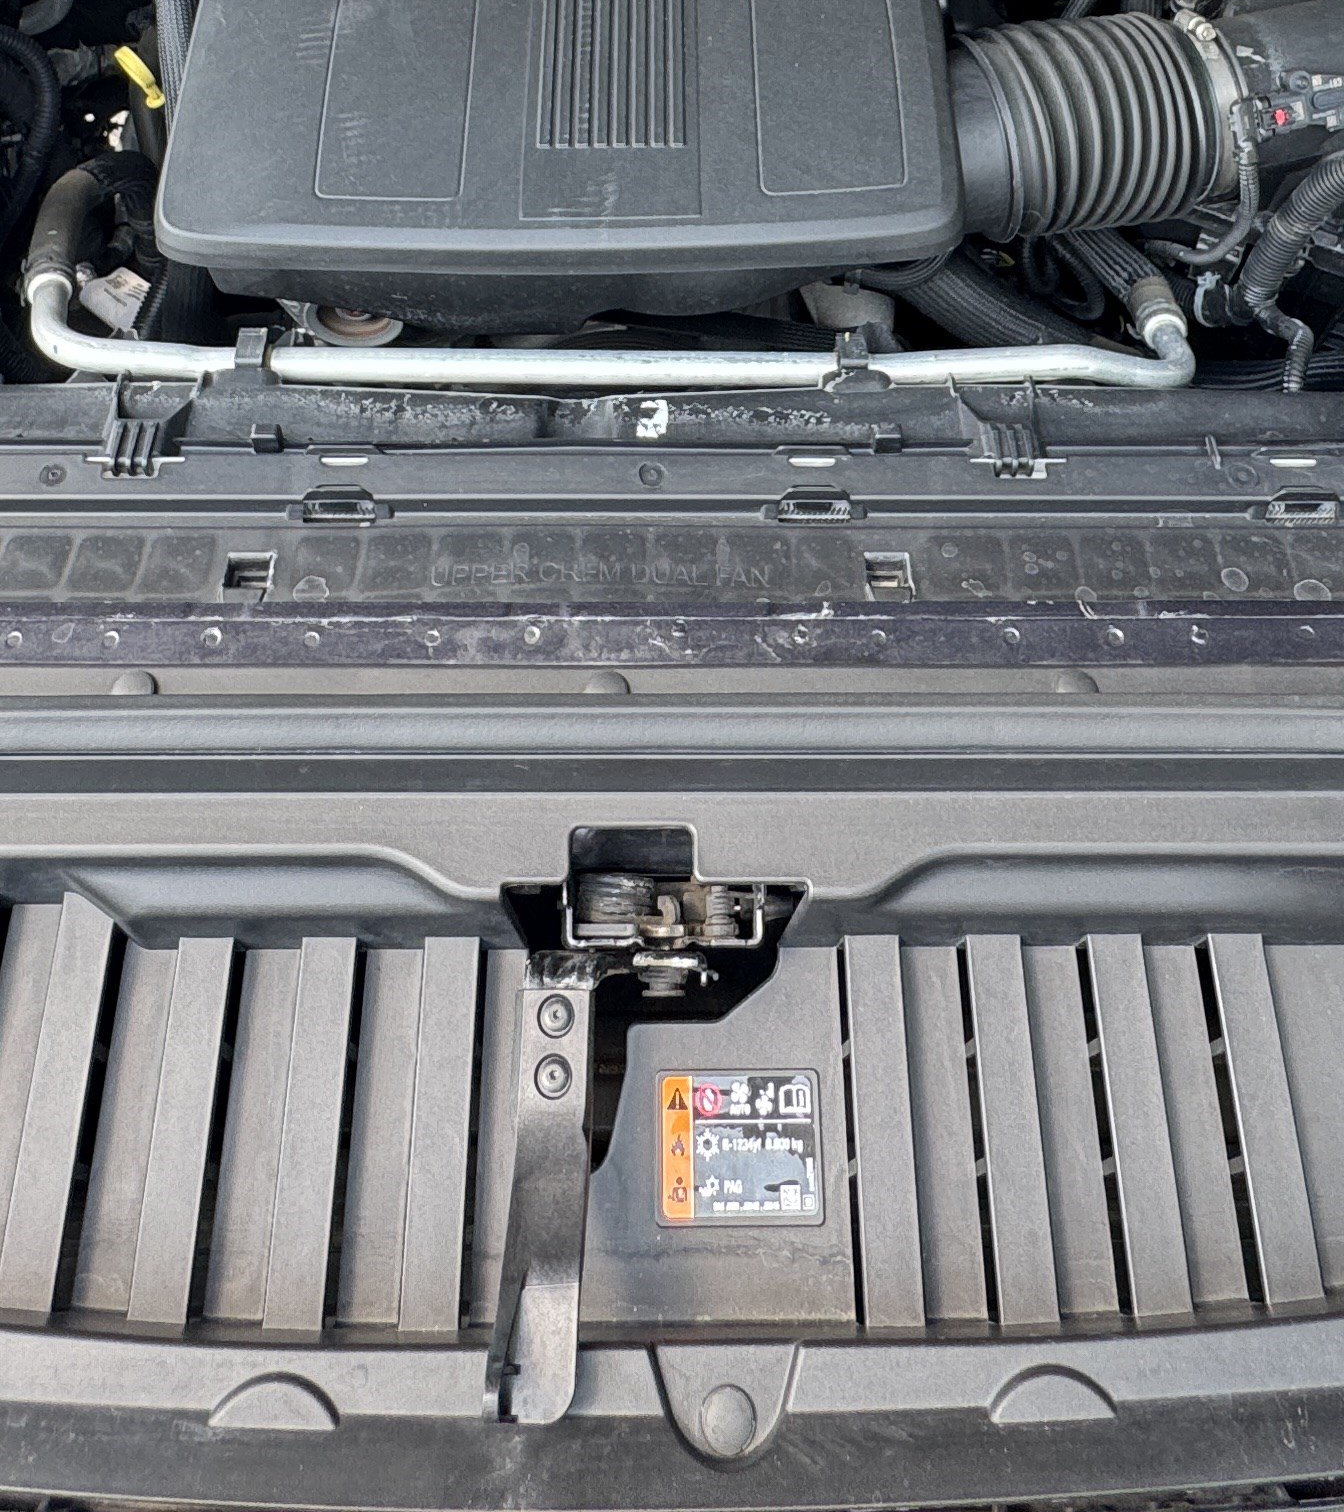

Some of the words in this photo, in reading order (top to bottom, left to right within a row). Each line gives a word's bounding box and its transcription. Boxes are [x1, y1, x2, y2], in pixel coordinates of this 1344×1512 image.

[430, 561, 532, 587] UPPER
[630, 561, 709, 586] DUAL
[715, 558, 771, 588] FAN
[729, 1103, 752, 1116] AUTO
